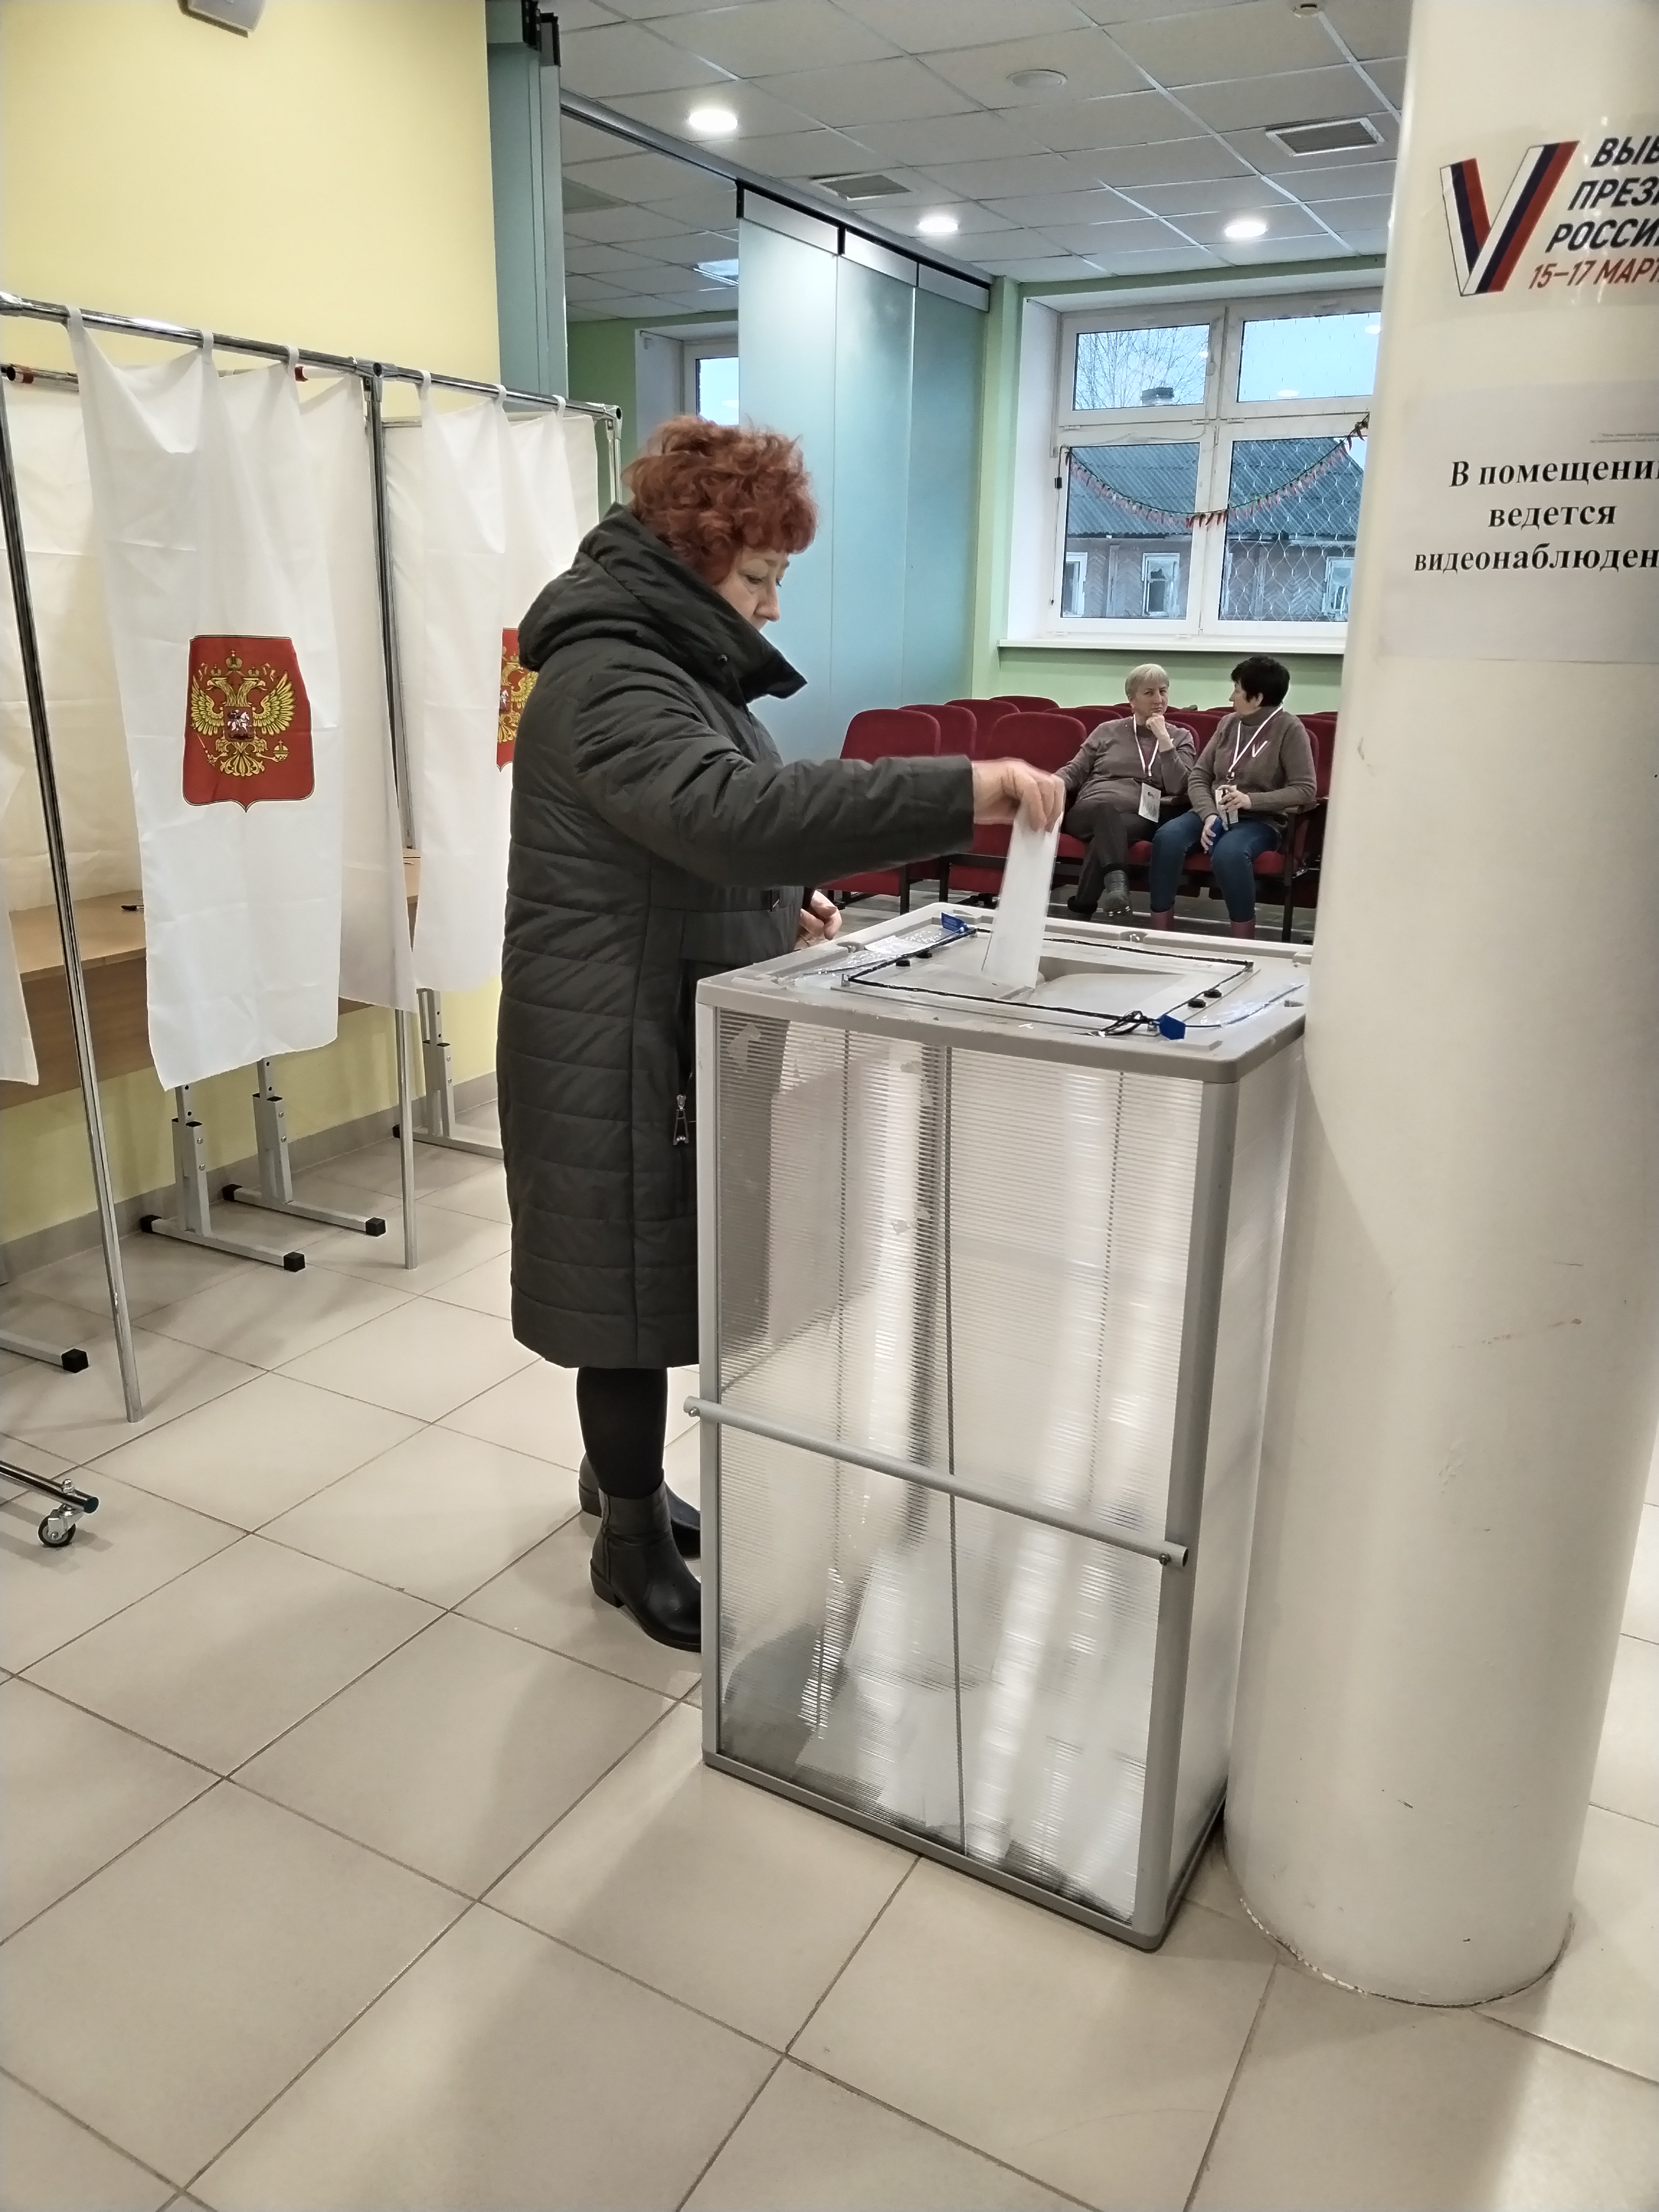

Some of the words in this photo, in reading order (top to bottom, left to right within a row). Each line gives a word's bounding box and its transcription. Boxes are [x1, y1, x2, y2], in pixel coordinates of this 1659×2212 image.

[1567, 176, 1659, 210] ПРЕЗ
[1545, 218, 1659, 253] РОССИ
[1449, 461, 1469, 487] В
[1478, 460, 1659, 485] помещени
[1488, 505, 1617, 530] ведется
[1414, 543, 1659, 574] видеонаблюден
